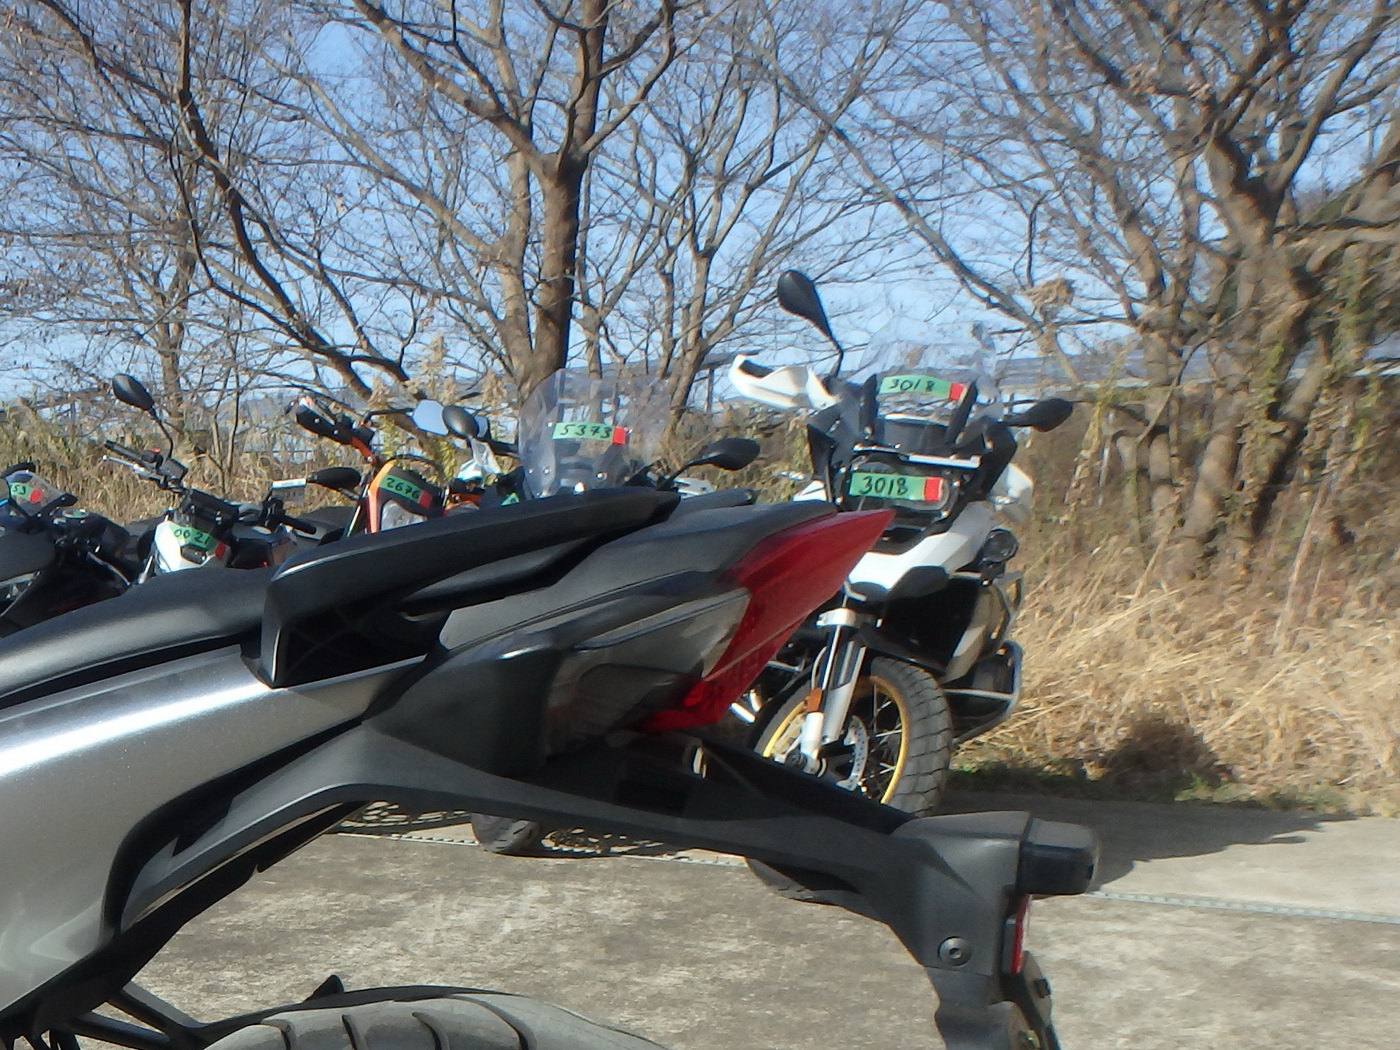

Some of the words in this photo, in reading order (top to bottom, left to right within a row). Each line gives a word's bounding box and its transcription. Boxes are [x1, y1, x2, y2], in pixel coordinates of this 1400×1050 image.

[888, 378, 936, 393] 3018
[560, 424, 612, 439] 5373
[859, 475, 908, 496] 3018
[173, 528, 210, 546] 0621
